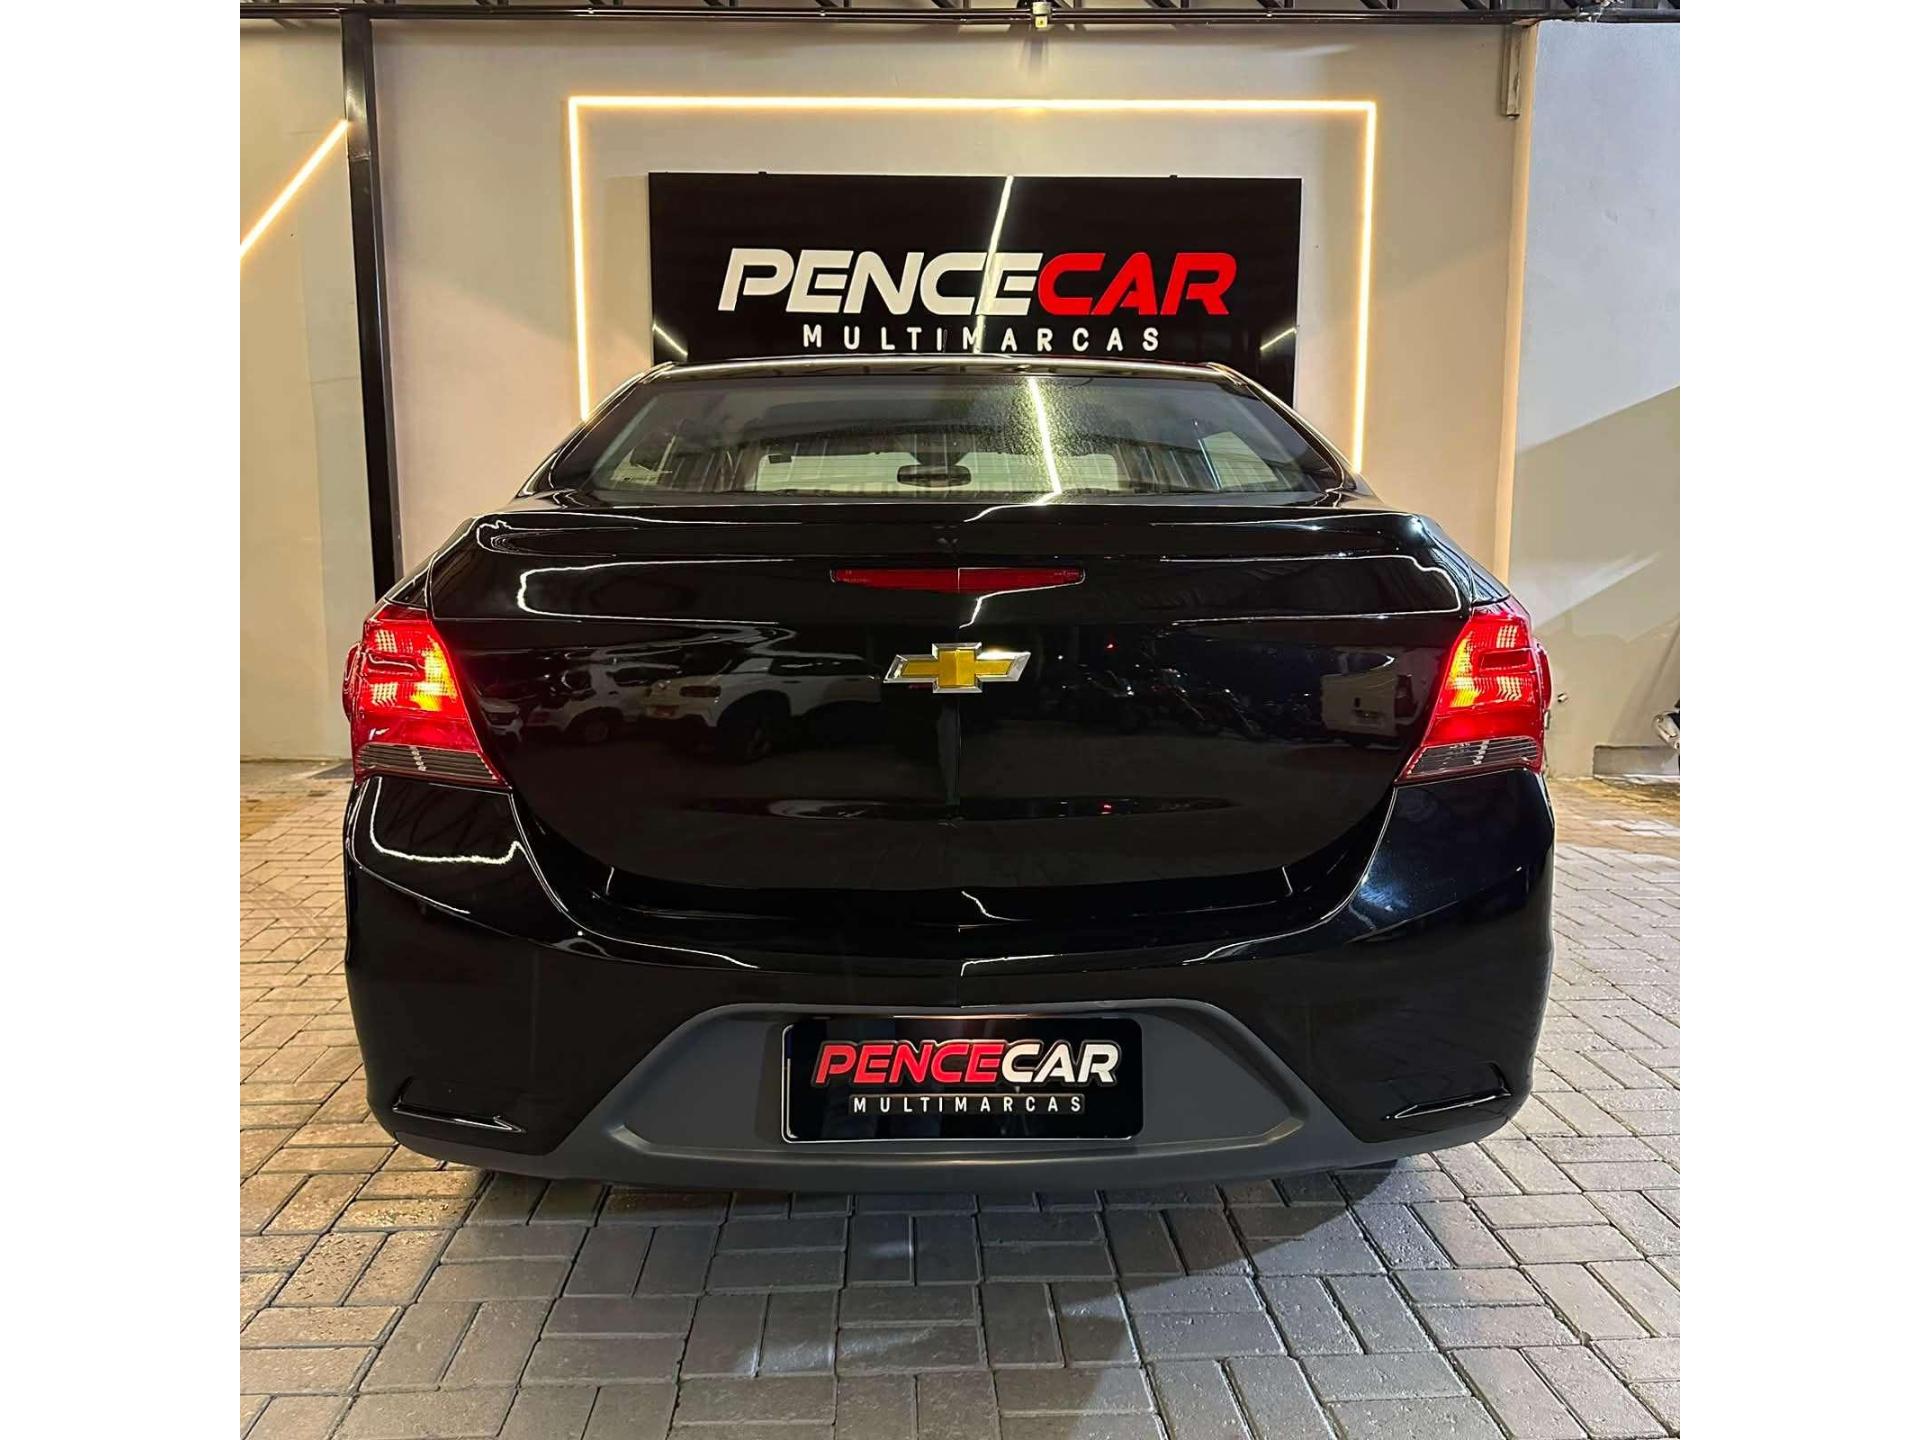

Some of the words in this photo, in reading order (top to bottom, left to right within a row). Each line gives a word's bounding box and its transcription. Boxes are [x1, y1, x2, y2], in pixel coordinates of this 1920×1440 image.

[717, 247, 1237, 316] PENCECAR
[801, 324, 1160, 352] MULTIMARCAS
[814, 1042, 1119, 1084] PENCECAR
[853, 1096, 1082, 1113] MULTIMARCAS
